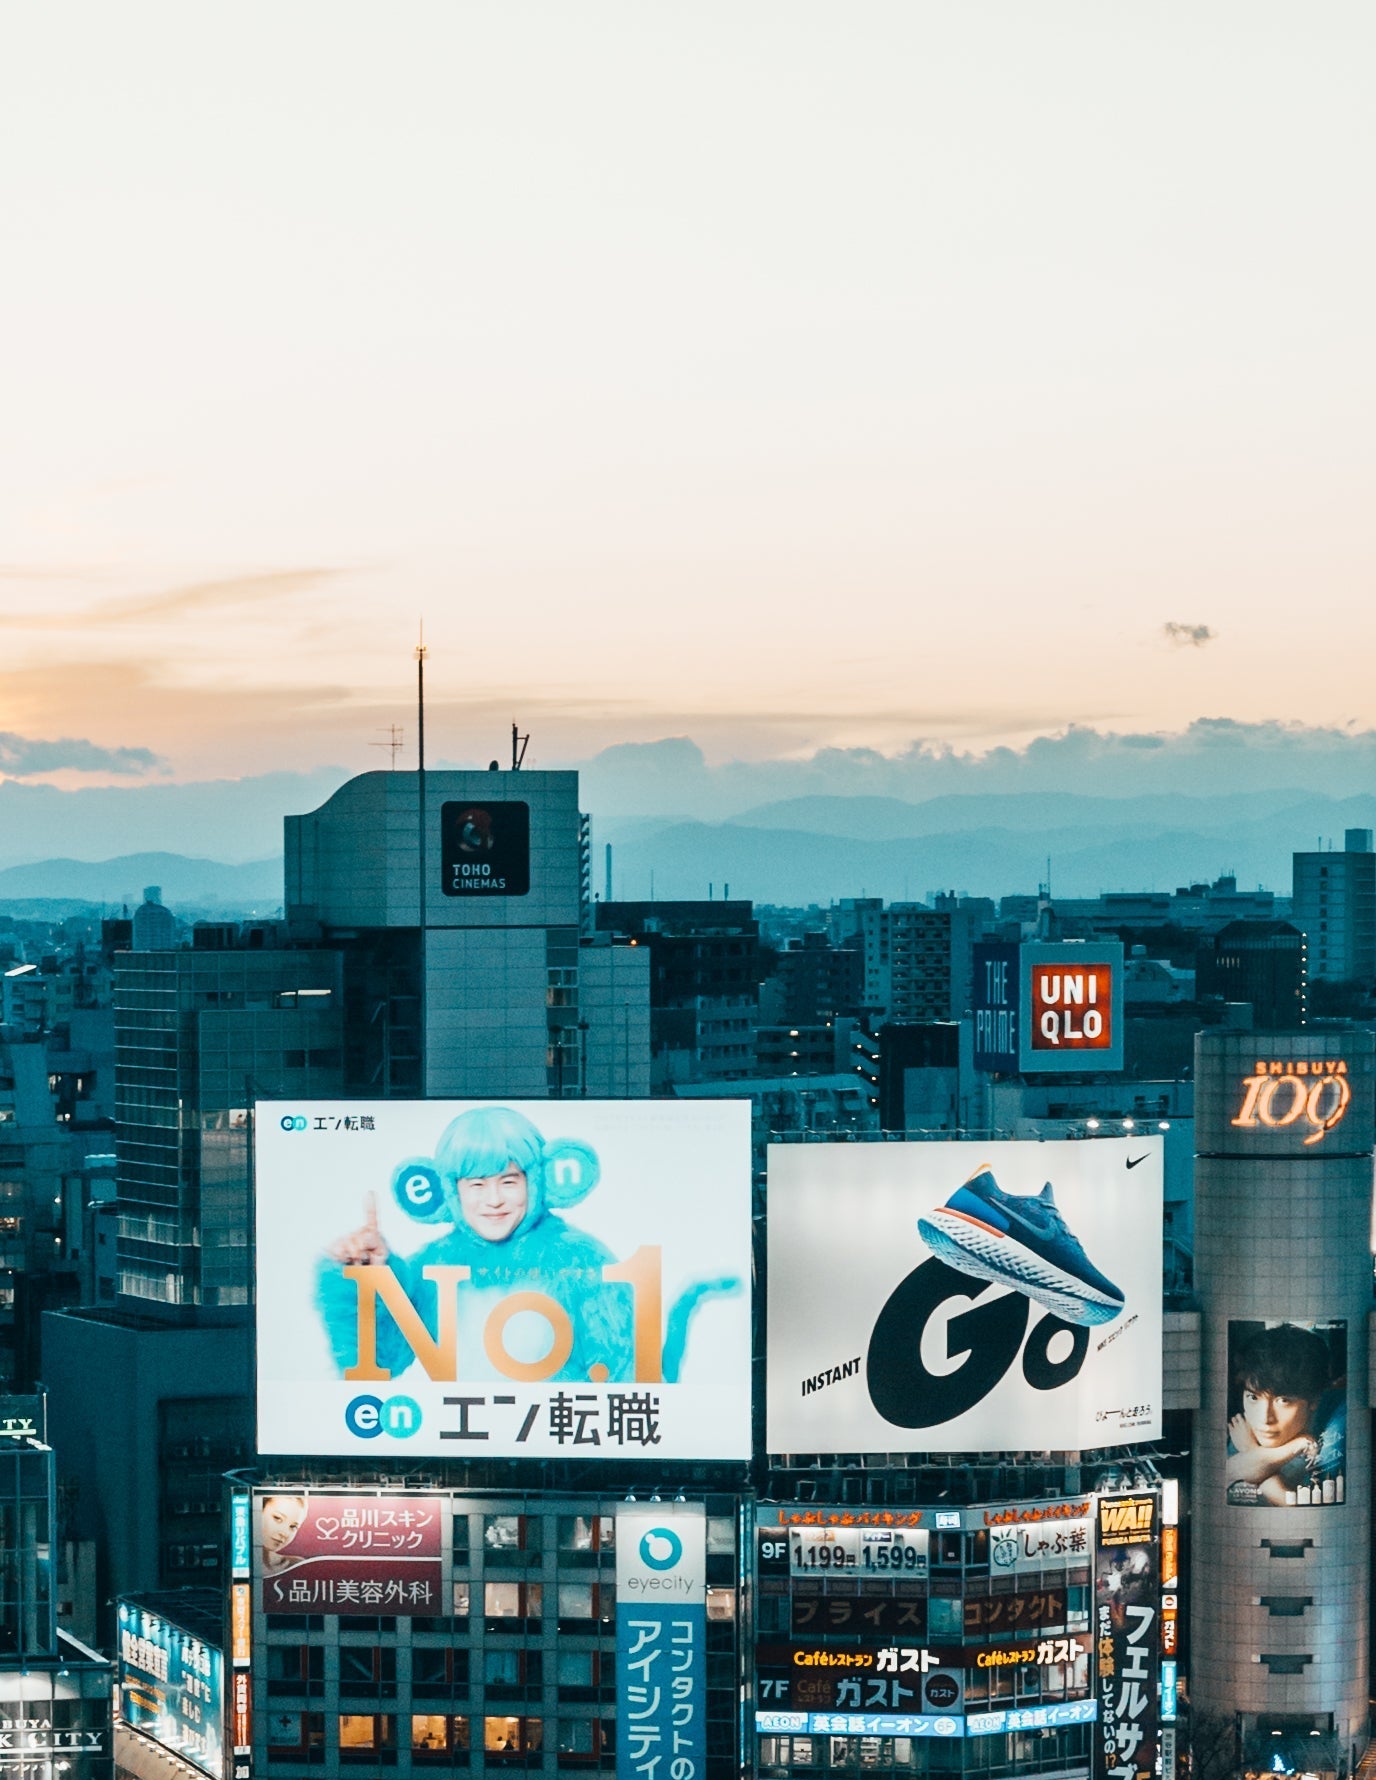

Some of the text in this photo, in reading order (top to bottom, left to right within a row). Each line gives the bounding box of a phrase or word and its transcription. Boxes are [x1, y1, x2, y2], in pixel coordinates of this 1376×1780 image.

[452, 864, 491, 876] TOHO
[452, 877, 506, 890] CINEMAS
[985, 960, 1009, 1006] THE
[1040, 974, 1097, 1006] UNI
[977, 1009, 1016, 1055] PRIME
[1040, 1009, 1102, 1045] QLO
[1254, 1060, 1347, 1076] SHIBUYA
[313, 1115, 376, 1131] エン転職
[1230, 1074, 1351, 1146] 109
[343, 1245, 663, 1383] No.1
[801, 1356, 862, 1397] INSTANT
[439, 1392, 662, 1447] エン転職
[340, 1508, 433, 1529] 品川スキン
[342, 1531, 424, 1549] クリニック
[761, 1543, 786, 1560] 9F
[1024, 1525, 1088, 1558] しゃぶ葉
[289, 1579, 433, 1605] 品川美容外科
[627, 1575, 695, 1595] eyecity
[793, 1601, 924, 1624] プライス
[964, 1594, 1064, 1626] コンタクト
[876, 1647, 940, 1673] ガスト
[1037, 1637, 1085, 1665] ガスト
[760, 1679, 790, 1698] 7F
[835, 1677, 914, 1708] ガスト
[761, 1715, 802, 1731] AEON
[812, 1714, 930, 1733] 英会話イーオン
[1006, 1704, 1094, 1730] 英会話イーオン
[27, 1733, 103, 1747] CITY
